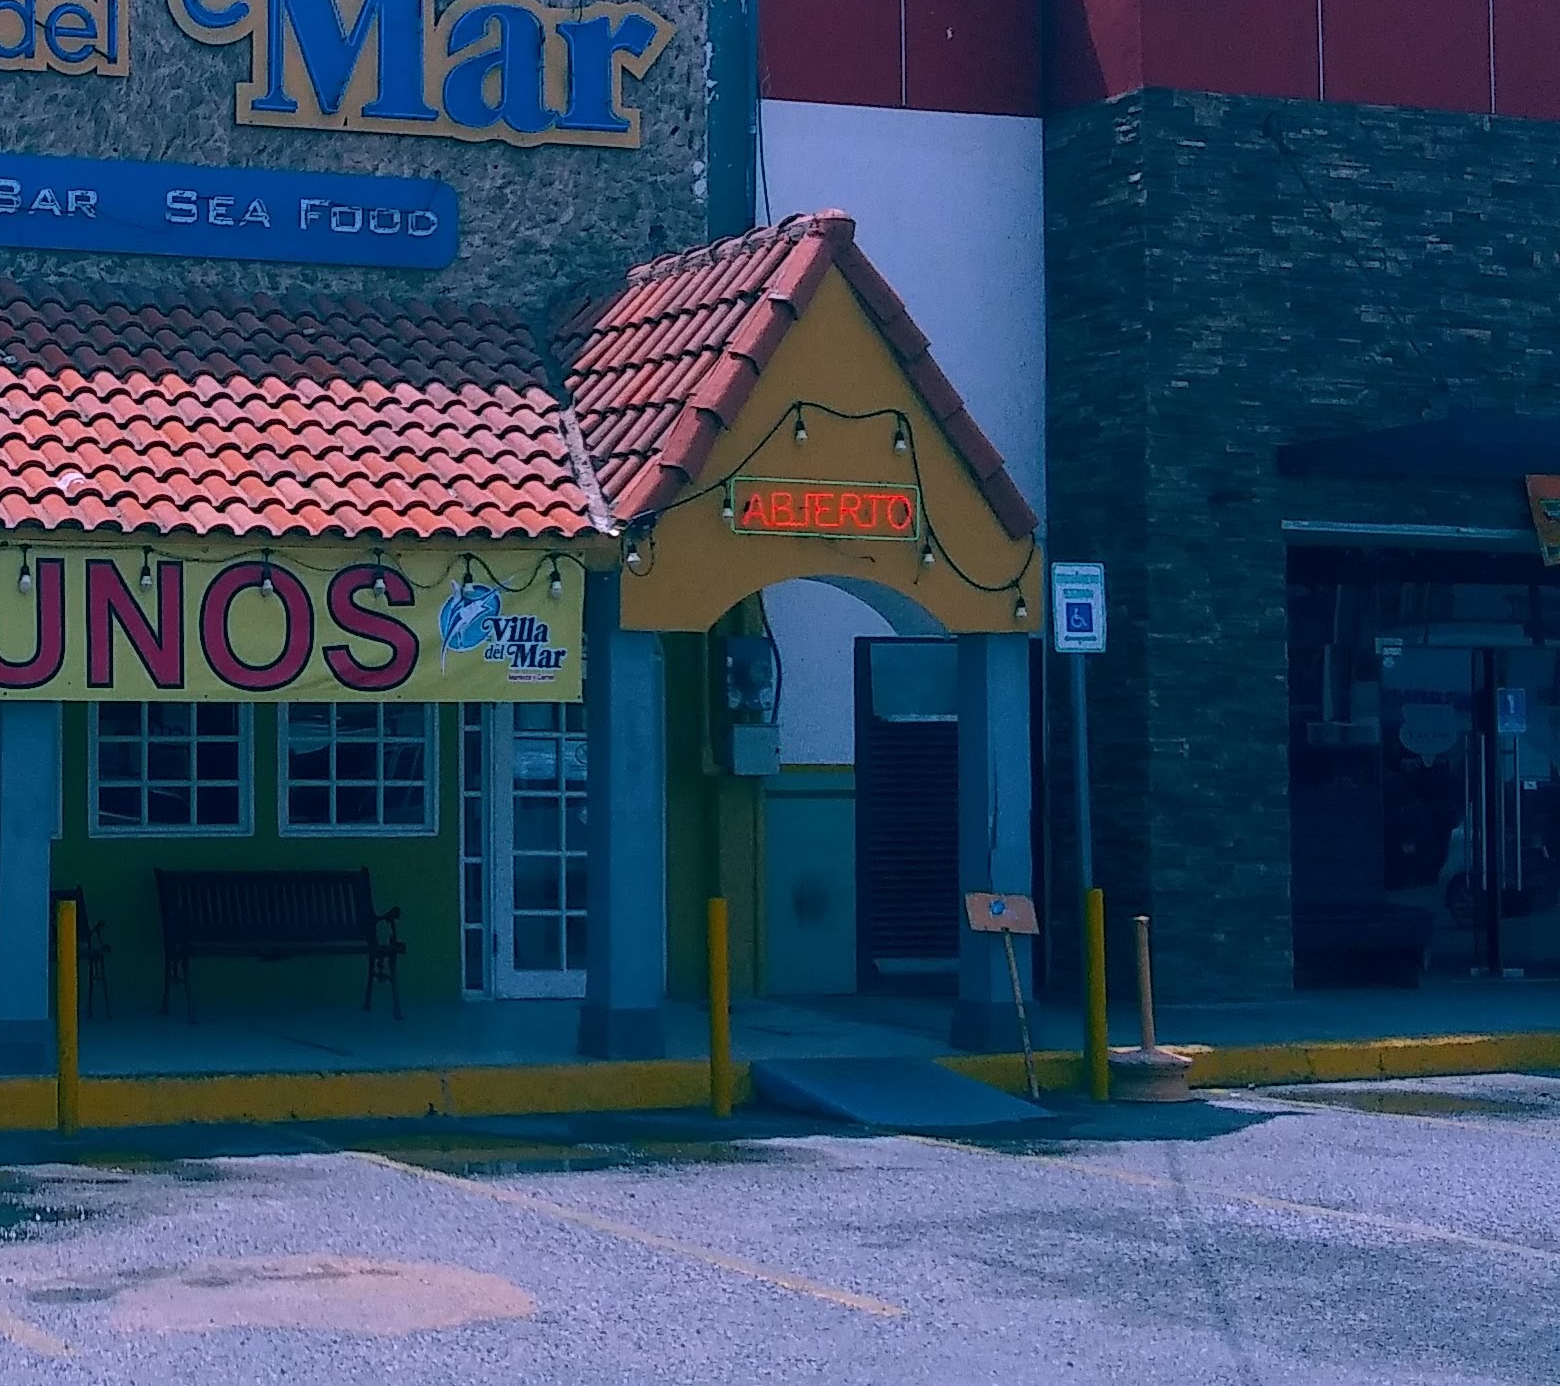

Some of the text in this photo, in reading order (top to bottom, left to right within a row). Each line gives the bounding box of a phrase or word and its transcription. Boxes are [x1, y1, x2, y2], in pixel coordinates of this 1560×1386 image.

[742, 491, 913, 531] ABIERTO
[481, 615, 549, 643] Villa
[485, 643, 567, 669] del Mar
